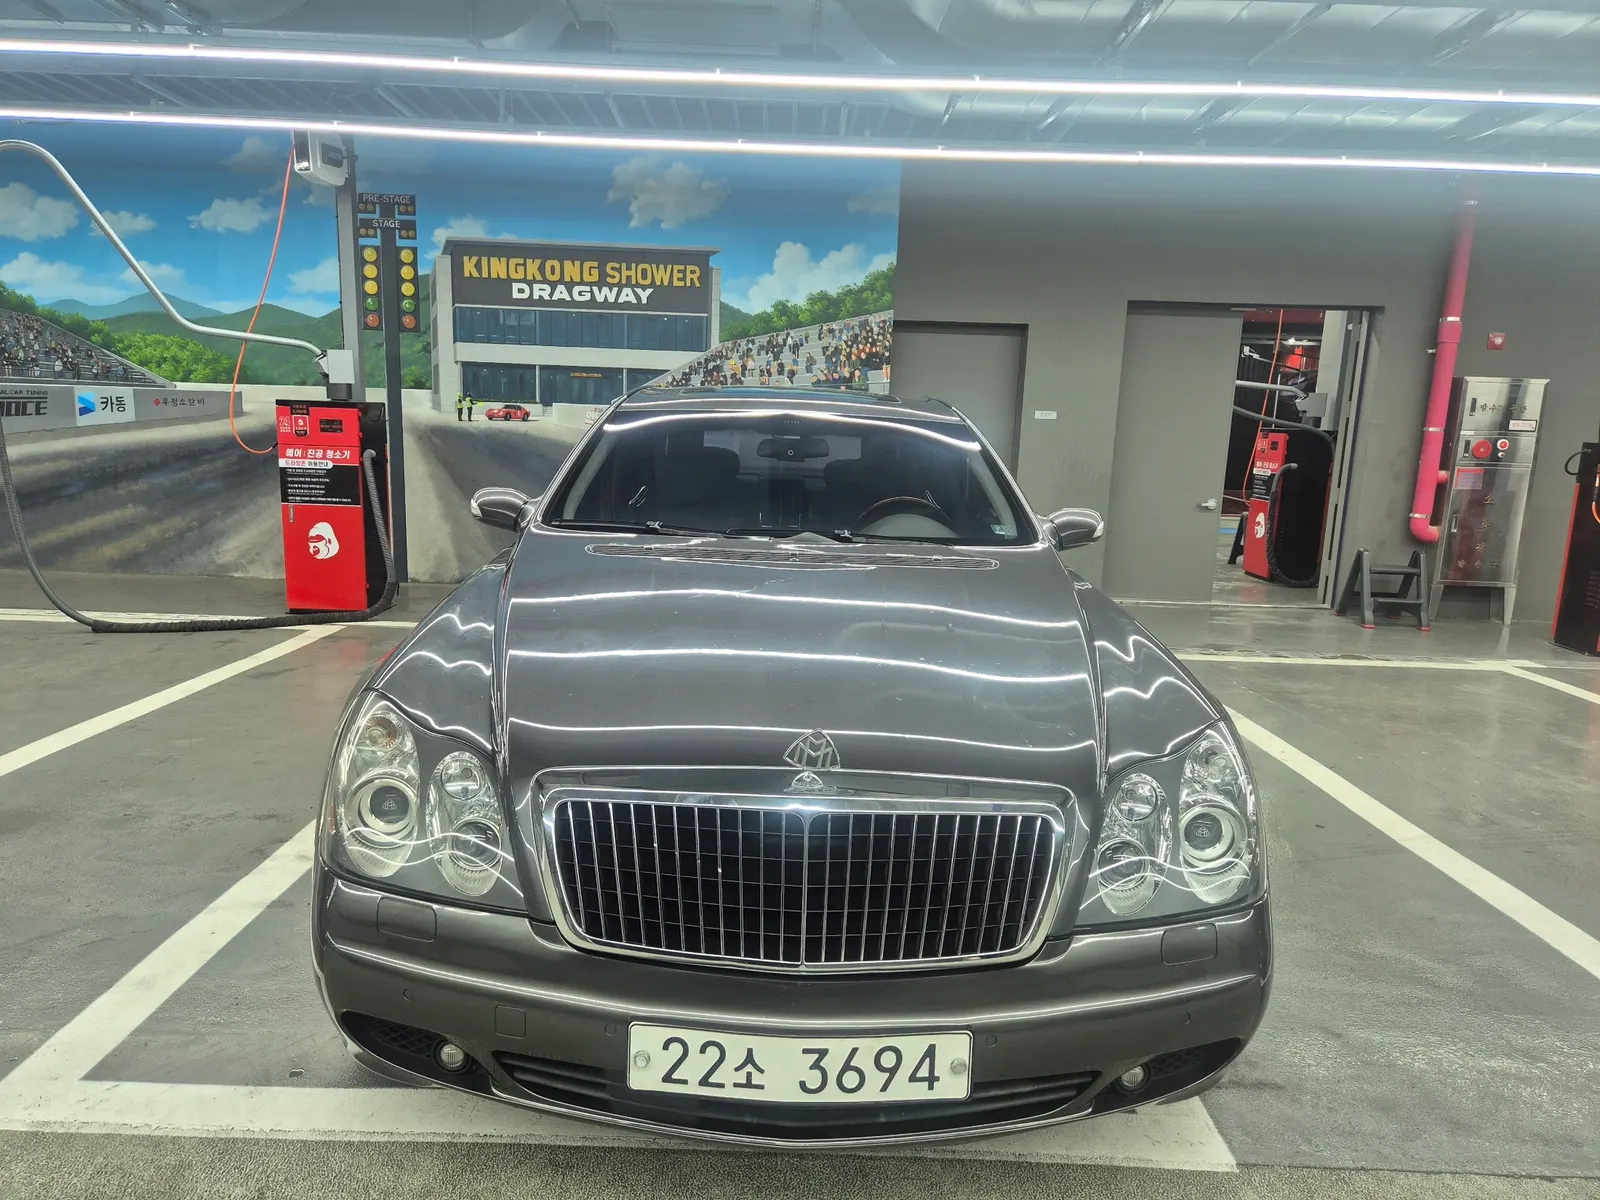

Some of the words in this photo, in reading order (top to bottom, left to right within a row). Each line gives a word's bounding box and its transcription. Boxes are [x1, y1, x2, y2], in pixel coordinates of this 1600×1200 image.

[372, 219, 400, 228] STAGE
[463, 255, 599, 283] KINGKONG
[605, 262, 701, 288] SHOWER
[512, 282, 654, 304] DRAGWAY
[100, 396, 126, 412] 카동
[162, 397, 205, 407] 우정소갈비
[286, 448, 302, 457] 에어
[307, 449, 324, 458] 진공
[326, 450, 350, 459] 청소기
[661, 1036, 765, 1090] 22소
[799, 1043, 940, 1094] 3694
